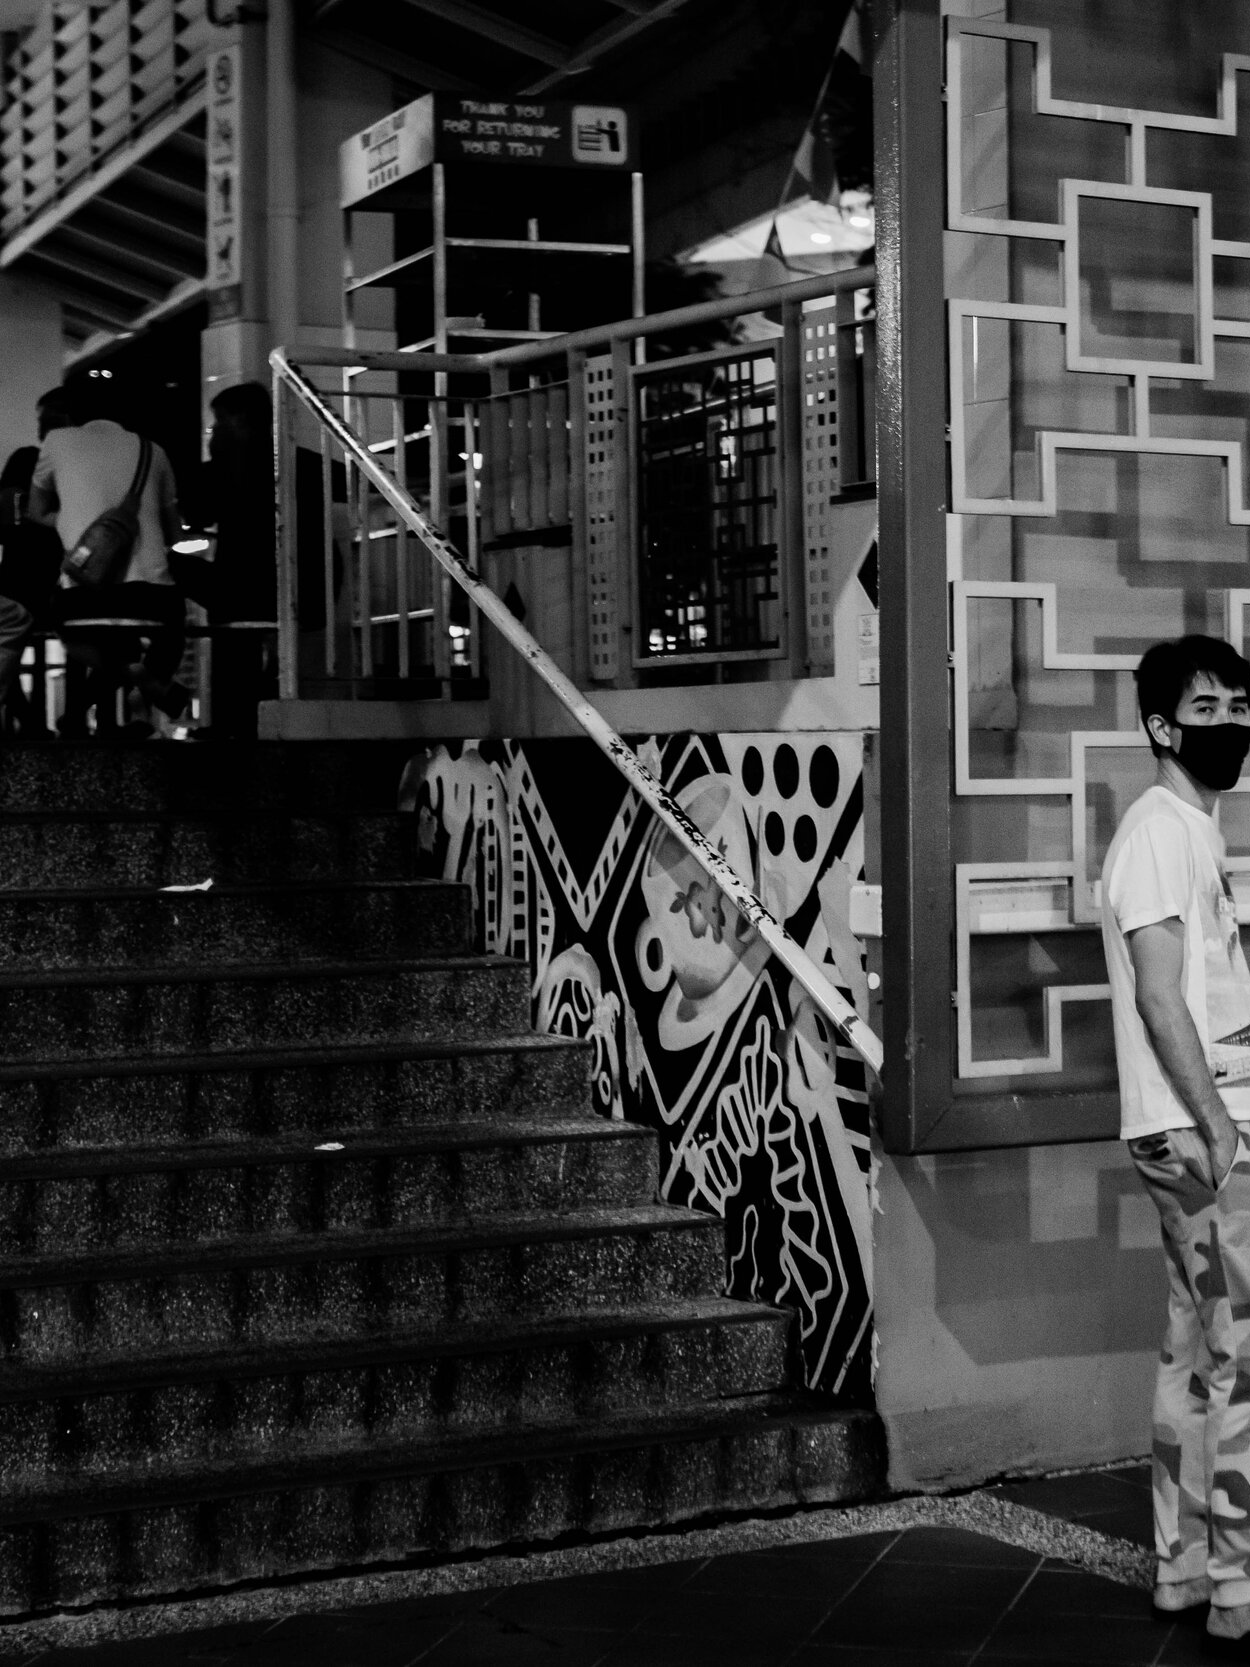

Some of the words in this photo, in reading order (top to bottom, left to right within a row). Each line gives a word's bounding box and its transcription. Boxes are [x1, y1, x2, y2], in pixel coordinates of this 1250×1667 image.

[514, 103, 546, 118] YOU
[442, 119, 472, 133] FOR
[476, 120, 561, 139] RETURNING
[461, 140, 502, 155] YOUR
[506, 141, 545, 157] TRAY
